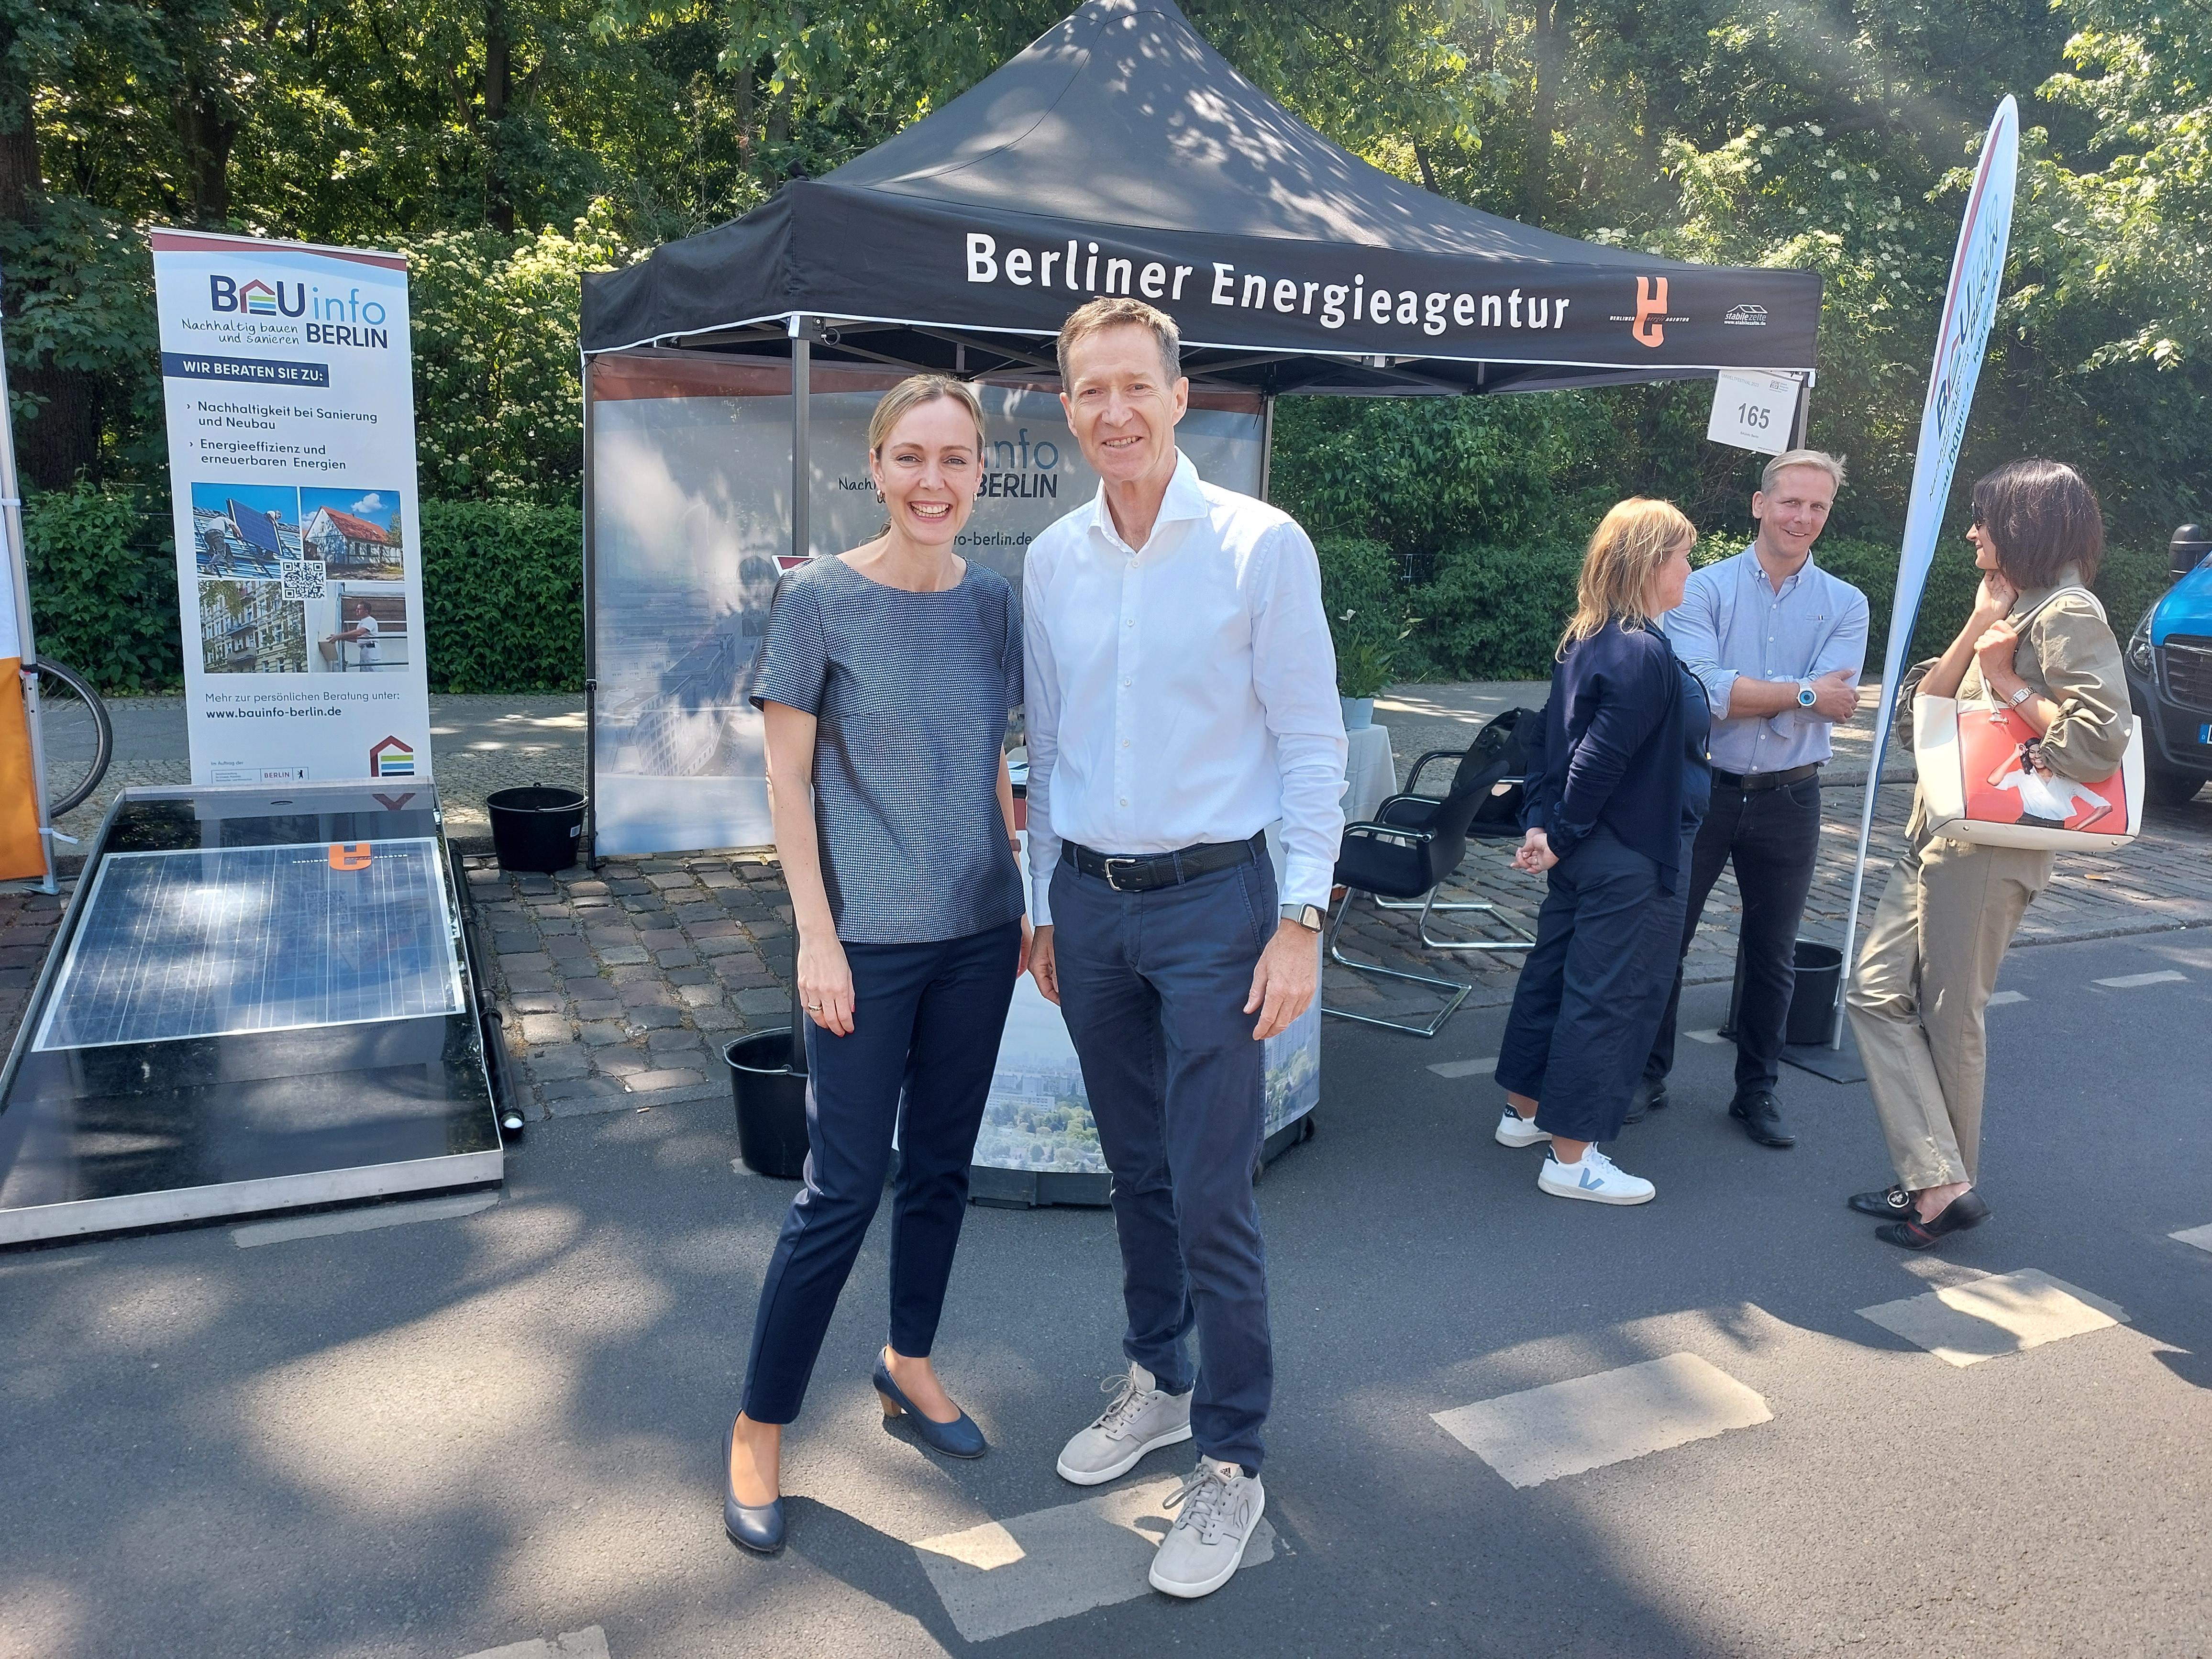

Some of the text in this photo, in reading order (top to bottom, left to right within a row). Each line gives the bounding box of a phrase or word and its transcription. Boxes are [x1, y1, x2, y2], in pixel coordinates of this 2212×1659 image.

[966, 233, 1571, 336] Berliner Energieagentur
[1725, 312, 1767, 321] stabilezelte
[181, 318, 299, 335] Nachhaltig bauen
[219, 333, 299, 345] und sanieren
[306, 323, 388, 349] BERLIN
[183, 361, 323, 381] WIR BERATEN SIE ZU:
[198, 401, 377, 424] Nachhaltigkeit bei Sanierung
[1738, 402, 1771, 430] 165
[199, 415, 276, 430] und Neubau
[200, 439, 326, 455] Energieeffizienz und
[201, 454, 346, 471] erneuerbaren Energien
[206, 692, 400, 705] Mehr zur persönlichen Beratung unter:
[206, 707, 342, 719] www.bauinfo-berlin.de
